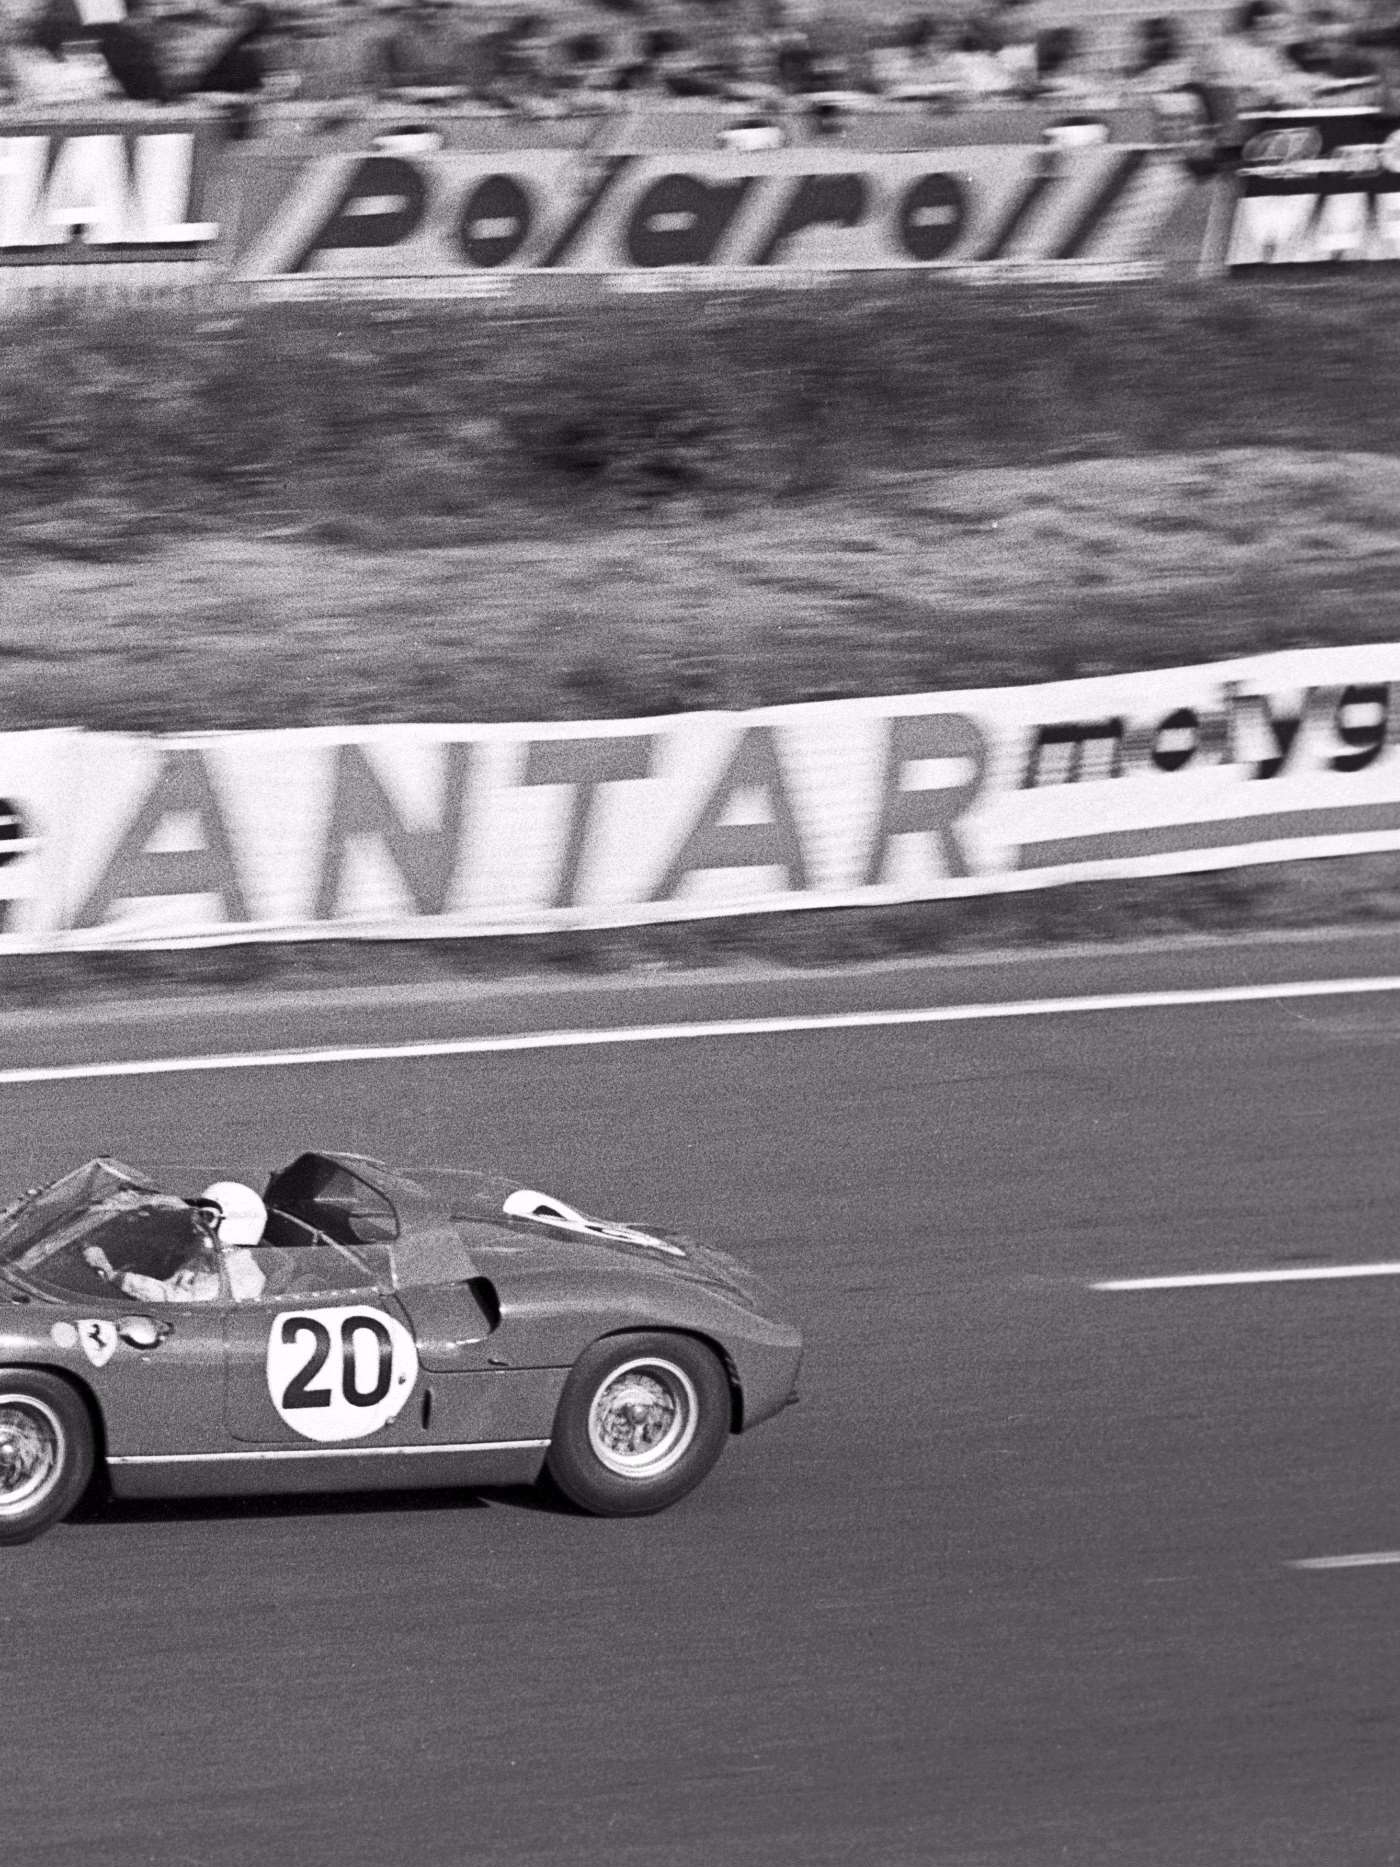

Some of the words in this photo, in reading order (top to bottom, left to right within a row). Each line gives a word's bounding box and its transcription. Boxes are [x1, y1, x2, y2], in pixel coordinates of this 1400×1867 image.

[1224, 190, 1400, 265] MA
[61, 711, 988, 930] ANTAR
[281, 1315, 393, 1410] 20
